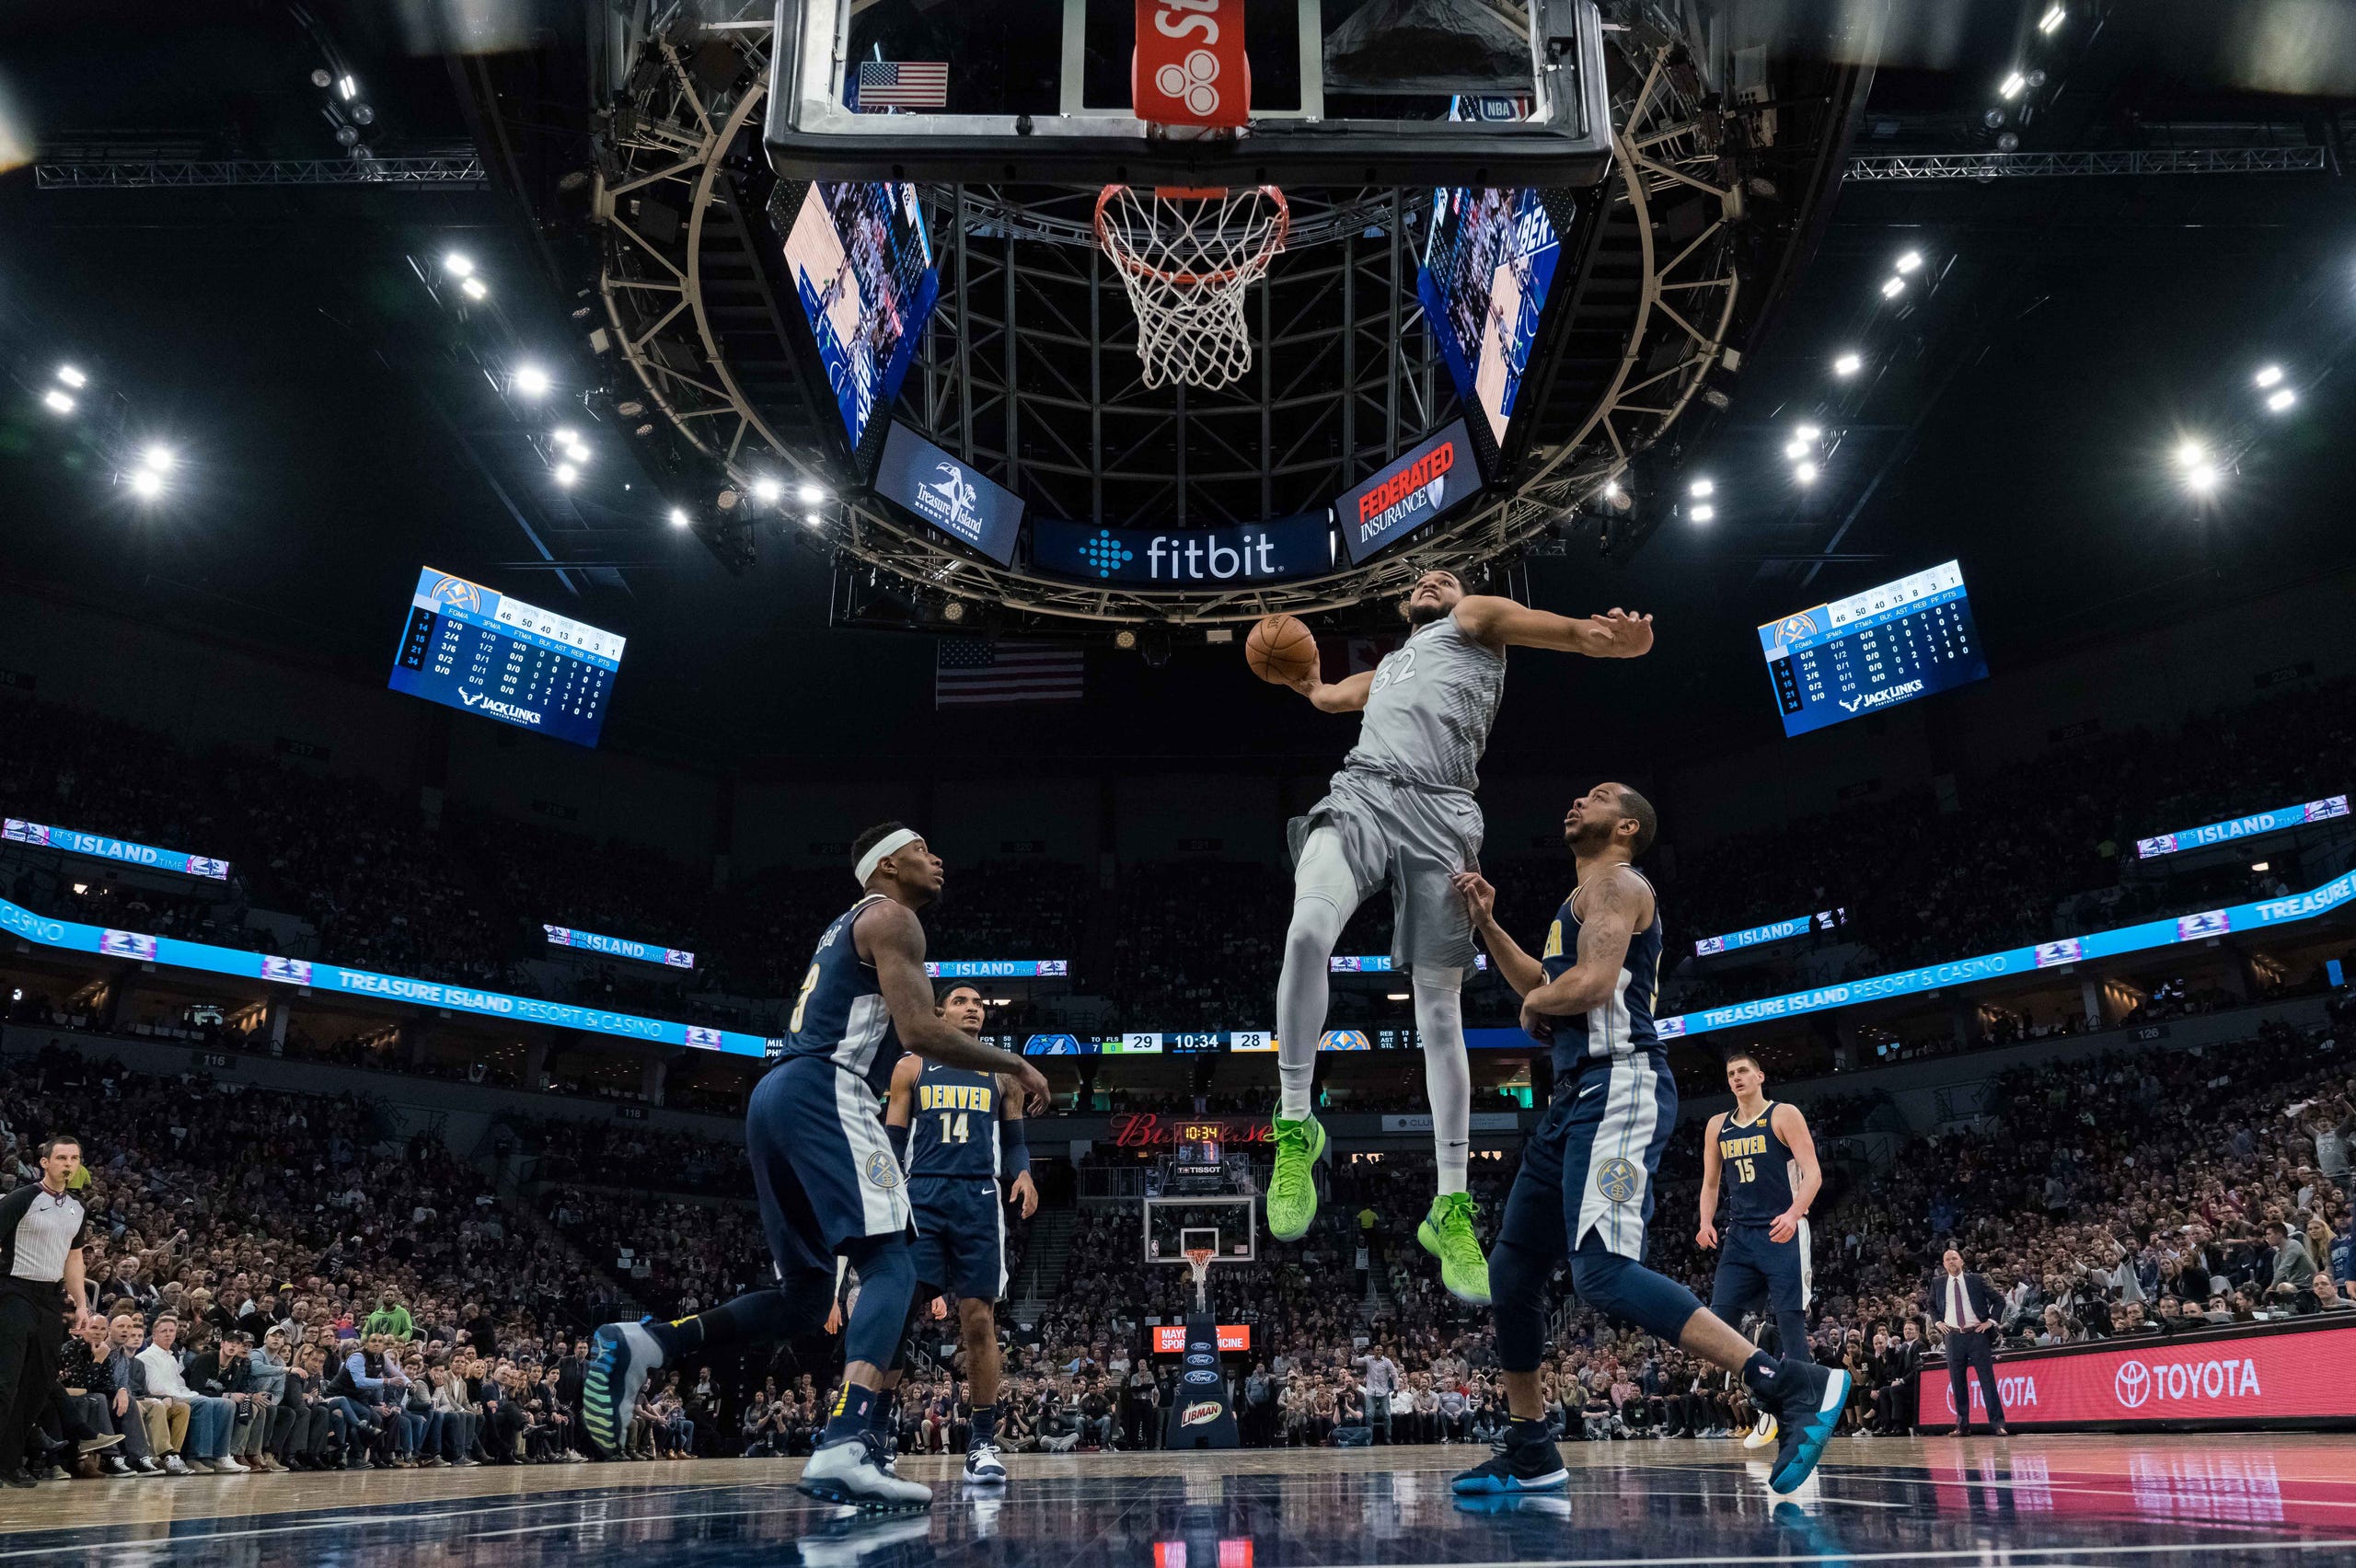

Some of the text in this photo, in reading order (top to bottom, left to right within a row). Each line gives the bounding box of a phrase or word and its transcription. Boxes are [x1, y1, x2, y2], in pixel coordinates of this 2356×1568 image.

[1488, 102, 1510, 116] NBA
[1359, 442, 1454, 524] FEDERATED
[914, 501, 942, 520] RESORT
[953, 523, 978, 541] CASINO
[917, 482, 983, 534] Treasure Island
[1361, 487, 1426, 543] INSURANCE
[1836, 614, 1846, 623] 46
[1856, 607, 1866, 616] 50
[1874, 601, 1885, 609] 40
[1894, 595, 1903, 603] 13
[1880, 612, 1892, 621] BLK
[1896, 607, 1907, 616] AST
[1913, 601, 1927, 610] REB
[1943, 591, 1956, 600] PTS
[448, 620, 463, 631] 0/0
[482, 632, 496, 641] 0/0
[513, 642, 527, 651] 0/0
[501, 612, 511, 621] 46
[522, 618, 532, 627] 50
[541, 626, 551, 634] 40
[560, 632, 569, 640] 13
[416, 635, 520, 673] 15 3/6 0/1 0/0
[419, 623, 523, 662] 14 2/4 1/2 0/0
[1800, 650, 1813, 660] 0/0
[1830, 640, 1844, 650] 0/0
[1860, 630, 1873, 640] 0/0
[1803, 661, 1816, 670] 2/4
[1834, 651, 1847, 660] 1/2
[1863, 641, 1876, 651] 0/0
[408, 657, 514, 695] 34 0/0 0/0 0/0
[411, 645, 517, 684] 21 0/2 0/1 0/0
[1370, 647, 1417, 694] 32
[1806, 671, 1819, 681] 3/6
[1836, 661, 1849, 671] 0/1
[1866, 651, 1879, 661] 0/0
[1786, 662, 1882, 699] 21 0/2 0/1 0/0
[1812, 692, 1825, 702] 0/0
[1842, 682, 1856, 692] 0/0
[1872, 673, 1885, 683] 0/0
[480, 697, 509, 715] JACK
[1864, 689, 1892, 707] JACK
[2179, 830, 2197, 841] IT'S
[2197, 815, 2275, 843] ISLAND
[55, 831, 73, 841] IT'S
[74, 835, 157, 863] ISLAND
[159, 858, 183, 869] TIME
[2256, 879, 2351, 920] TREASURE
[573, 932, 663, 960] IT'S ISLAND TIME
[1738, 923, 1794, 945] ISLAND
[957, 963, 1014, 976] ISLAND
[338, 970, 442, 1002] TREASURE
[445, 989, 513, 1013] ISLAND
[517, 1001, 582, 1024] RESORT
[603, 1015, 663, 1037] CASINO
[790, 963, 820, 1033] 3
[1704, 999, 1785, 1026] TREASURE
[1788, 988, 1849, 1011] ISLAND
[1853, 972, 1917, 998] RESORT
[1937, 956, 2007, 982] CASINO
[1133, 1036, 1153, 1048] 29
[1175, 1035, 1260, 1048] 10:34 28
[2139, 1028, 2159, 1039] 126
[204, 1054, 225, 1066] 116
[626, 1109, 641, 1118] 118
[920, 1085, 991, 1113] DENVER
[939, 1113, 969, 1143] 14
[1185, 1127, 1217, 1139] 10:34
[1202, 1141, 1213, 1160] 7
[1720, 1135, 1767, 1160] DENVER
[1734, 1158, 1756, 1183] 15
[1162, 1338, 1243, 1349] SPOR ICINE
[1190, 1372, 1211, 1382] Ford
[2154, 1358, 2261, 1400] TOYOTA
[1183, 1405, 1218, 1424] LIBMAN
